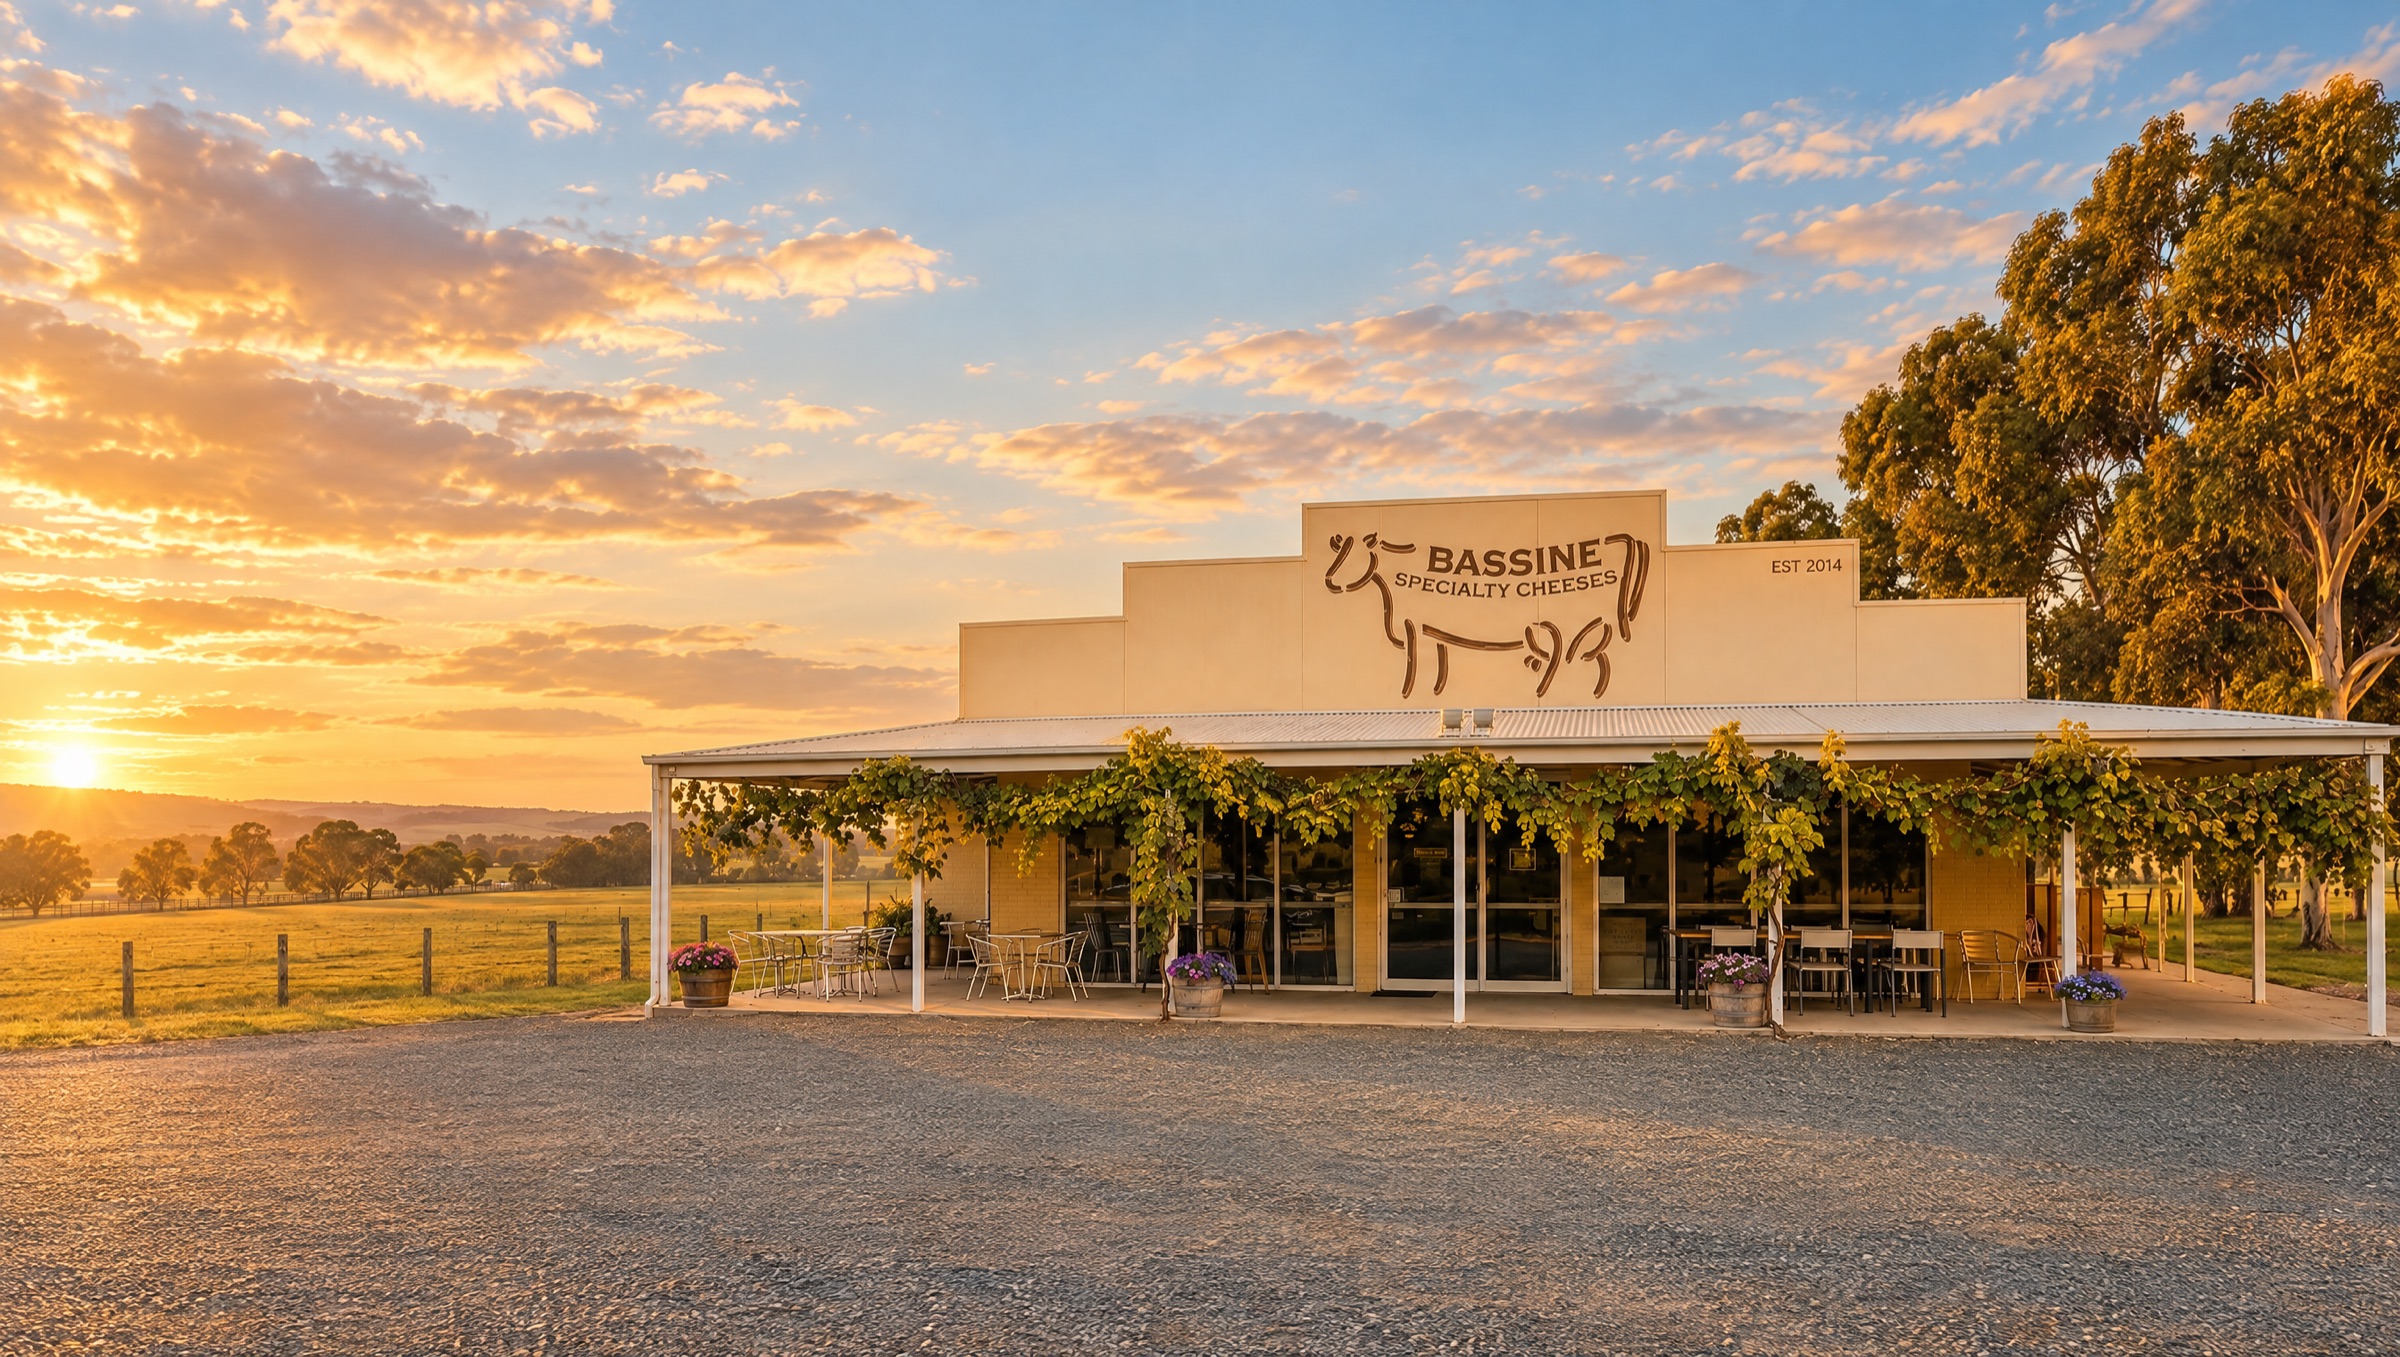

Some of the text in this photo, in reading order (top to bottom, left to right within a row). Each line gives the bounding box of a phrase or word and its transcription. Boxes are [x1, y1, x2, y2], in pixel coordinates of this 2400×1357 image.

[1427, 538, 1602, 577] BASSINE
[1772, 558, 1842, 573] EST 2014
[1395, 570, 1618, 598] SPECIALTY CHEESES
